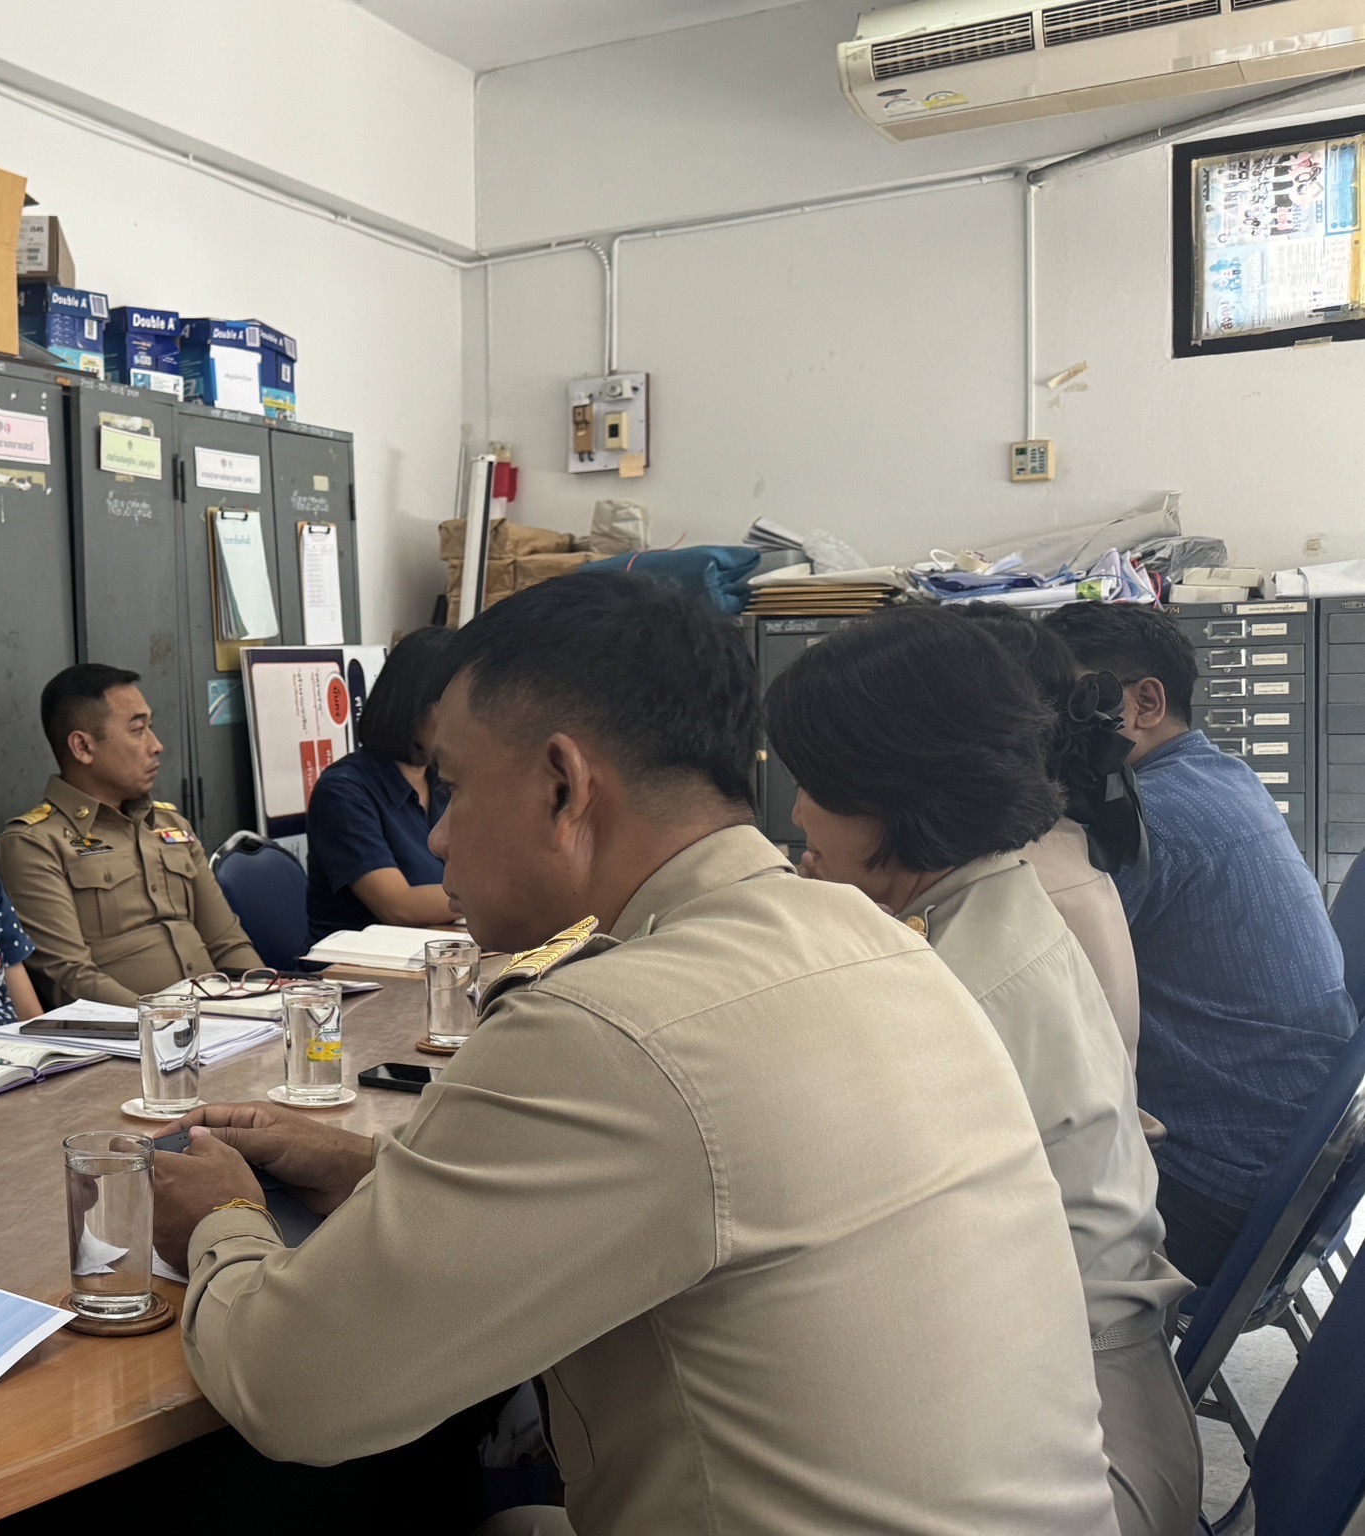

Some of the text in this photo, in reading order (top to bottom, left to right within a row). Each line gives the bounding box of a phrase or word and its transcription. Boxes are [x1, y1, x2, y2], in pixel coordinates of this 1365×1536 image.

[51, 292, 88, 309] Double A
[132, 313, 176, 331] Double A
[213, 328, 245, 341] Double A
